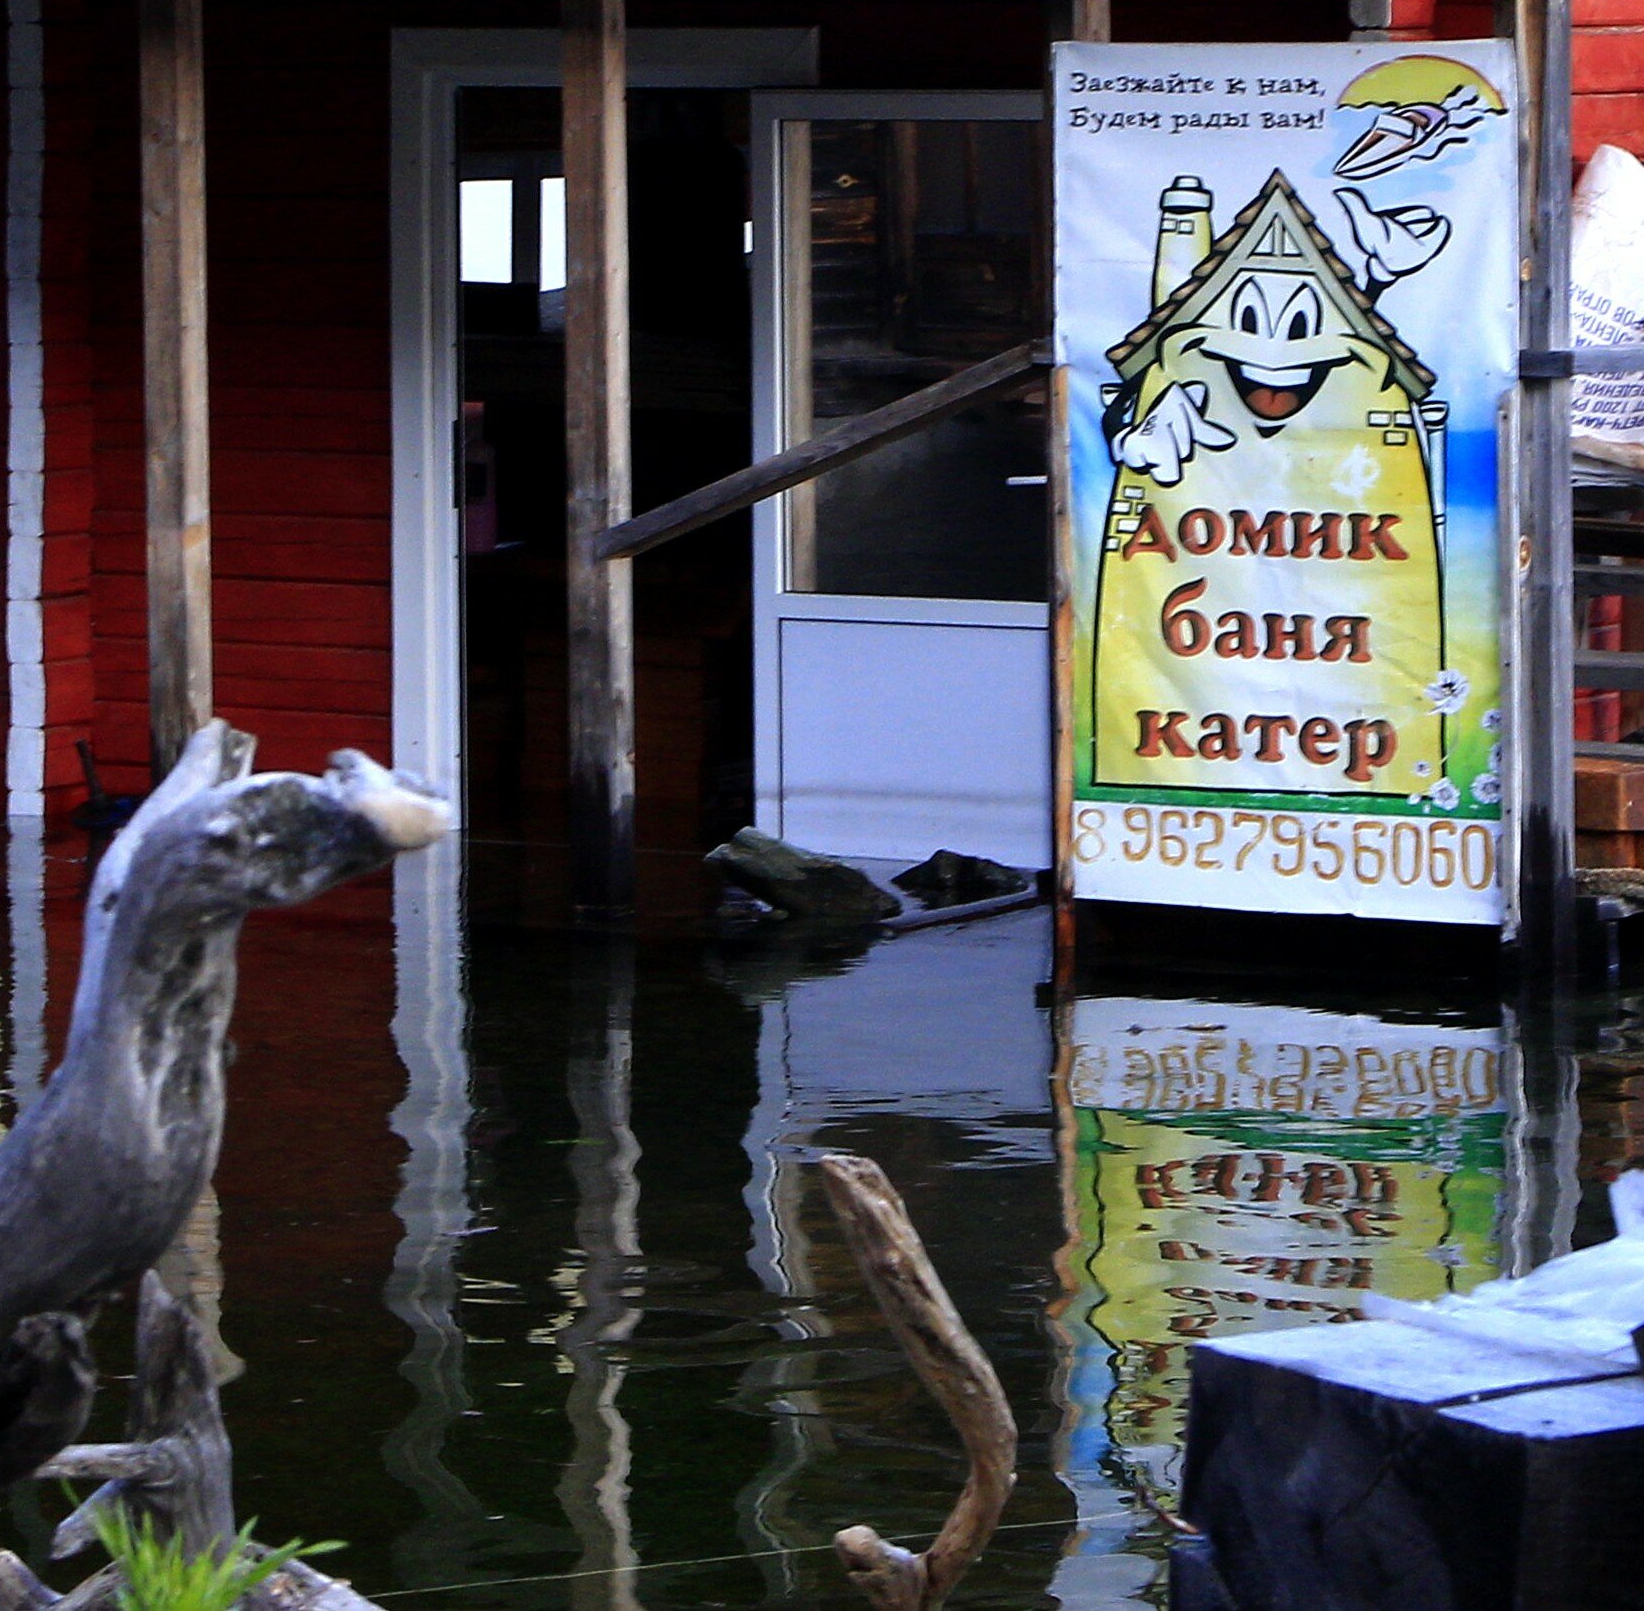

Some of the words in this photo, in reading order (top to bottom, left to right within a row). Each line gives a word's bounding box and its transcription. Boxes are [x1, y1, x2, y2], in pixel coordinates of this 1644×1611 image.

[1069, 72, 1214, 94] Заезжайте
[1226, 77, 1246, 94] к
[1257, 77, 1326, 97] нам,
[1069, 105, 1162, 134] Будем
[1169, 111, 1250, 135] рады
[1261, 108, 1325, 130] вам!
[1161, 577, 1372, 663] баня
[1134, 709, 1398, 782] катер
[1121, 806, 1495, 890] 9627956060
